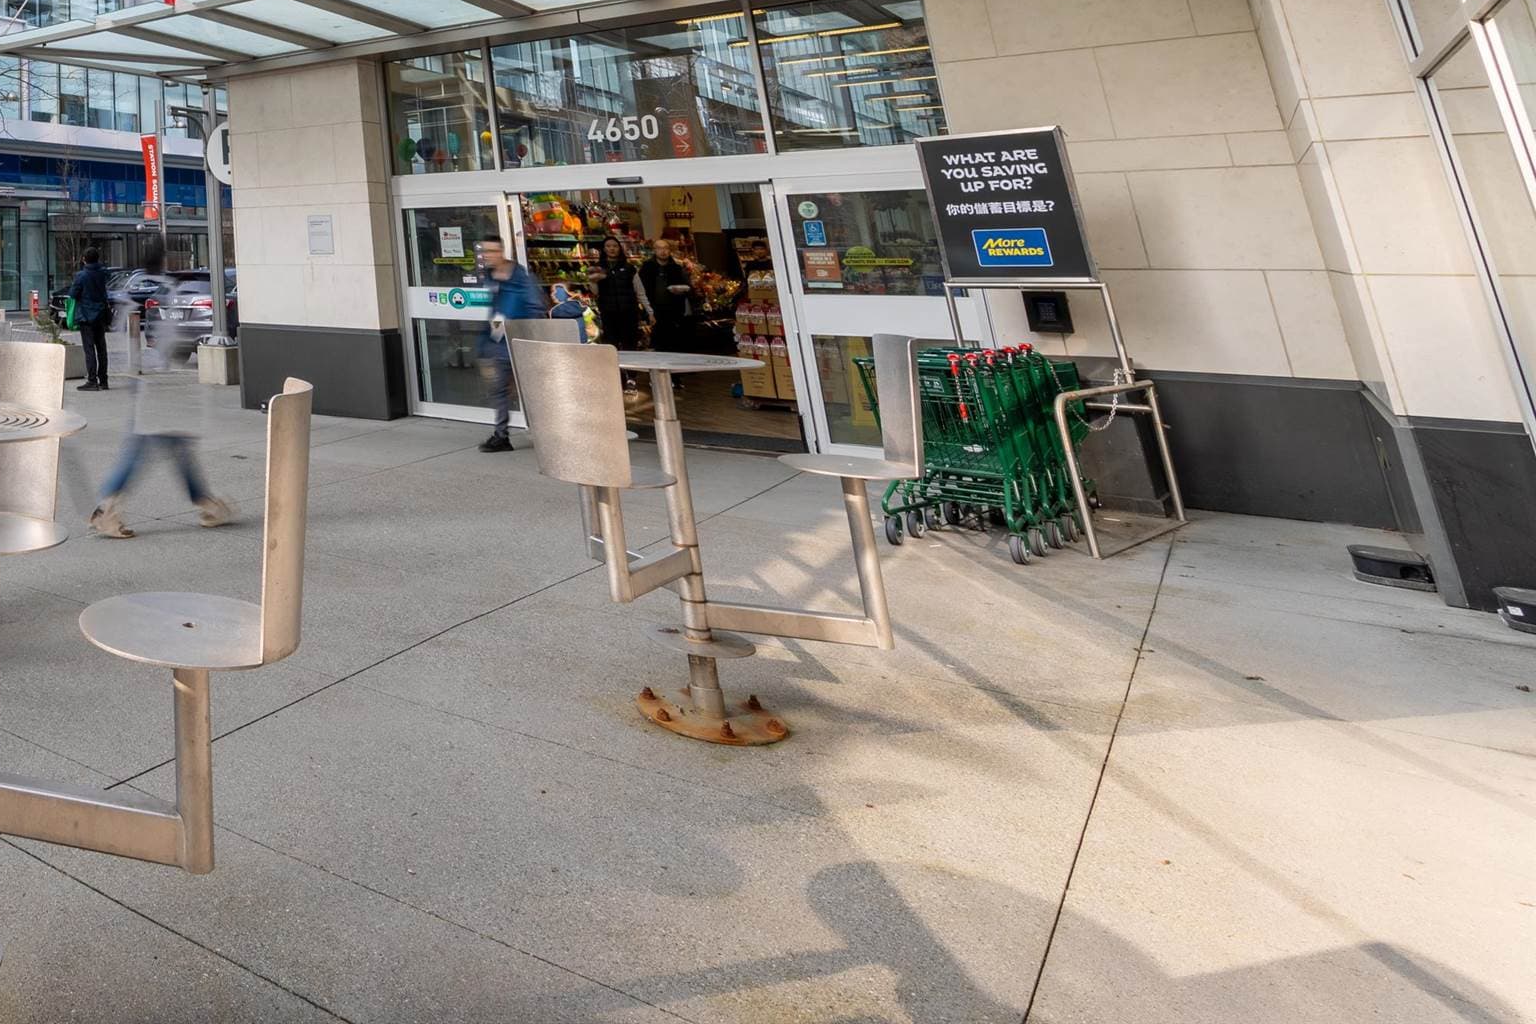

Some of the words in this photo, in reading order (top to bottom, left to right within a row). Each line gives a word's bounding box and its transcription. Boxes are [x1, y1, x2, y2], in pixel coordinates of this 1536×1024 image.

[587, 114, 659, 143] 4650
[147, 144, 158, 177] STATION
[942, 151, 996, 166] WHAT
[1000, 148, 1039, 163] ARE
[940, 165, 979, 180] YOU
[980, 162, 1048, 178] SAVING
[959, 180, 985, 193] UP
[988, 176, 1034, 192] FOR?
[981, 237, 1025, 251] More
[987, 247, 1045, 257] REWARDS
